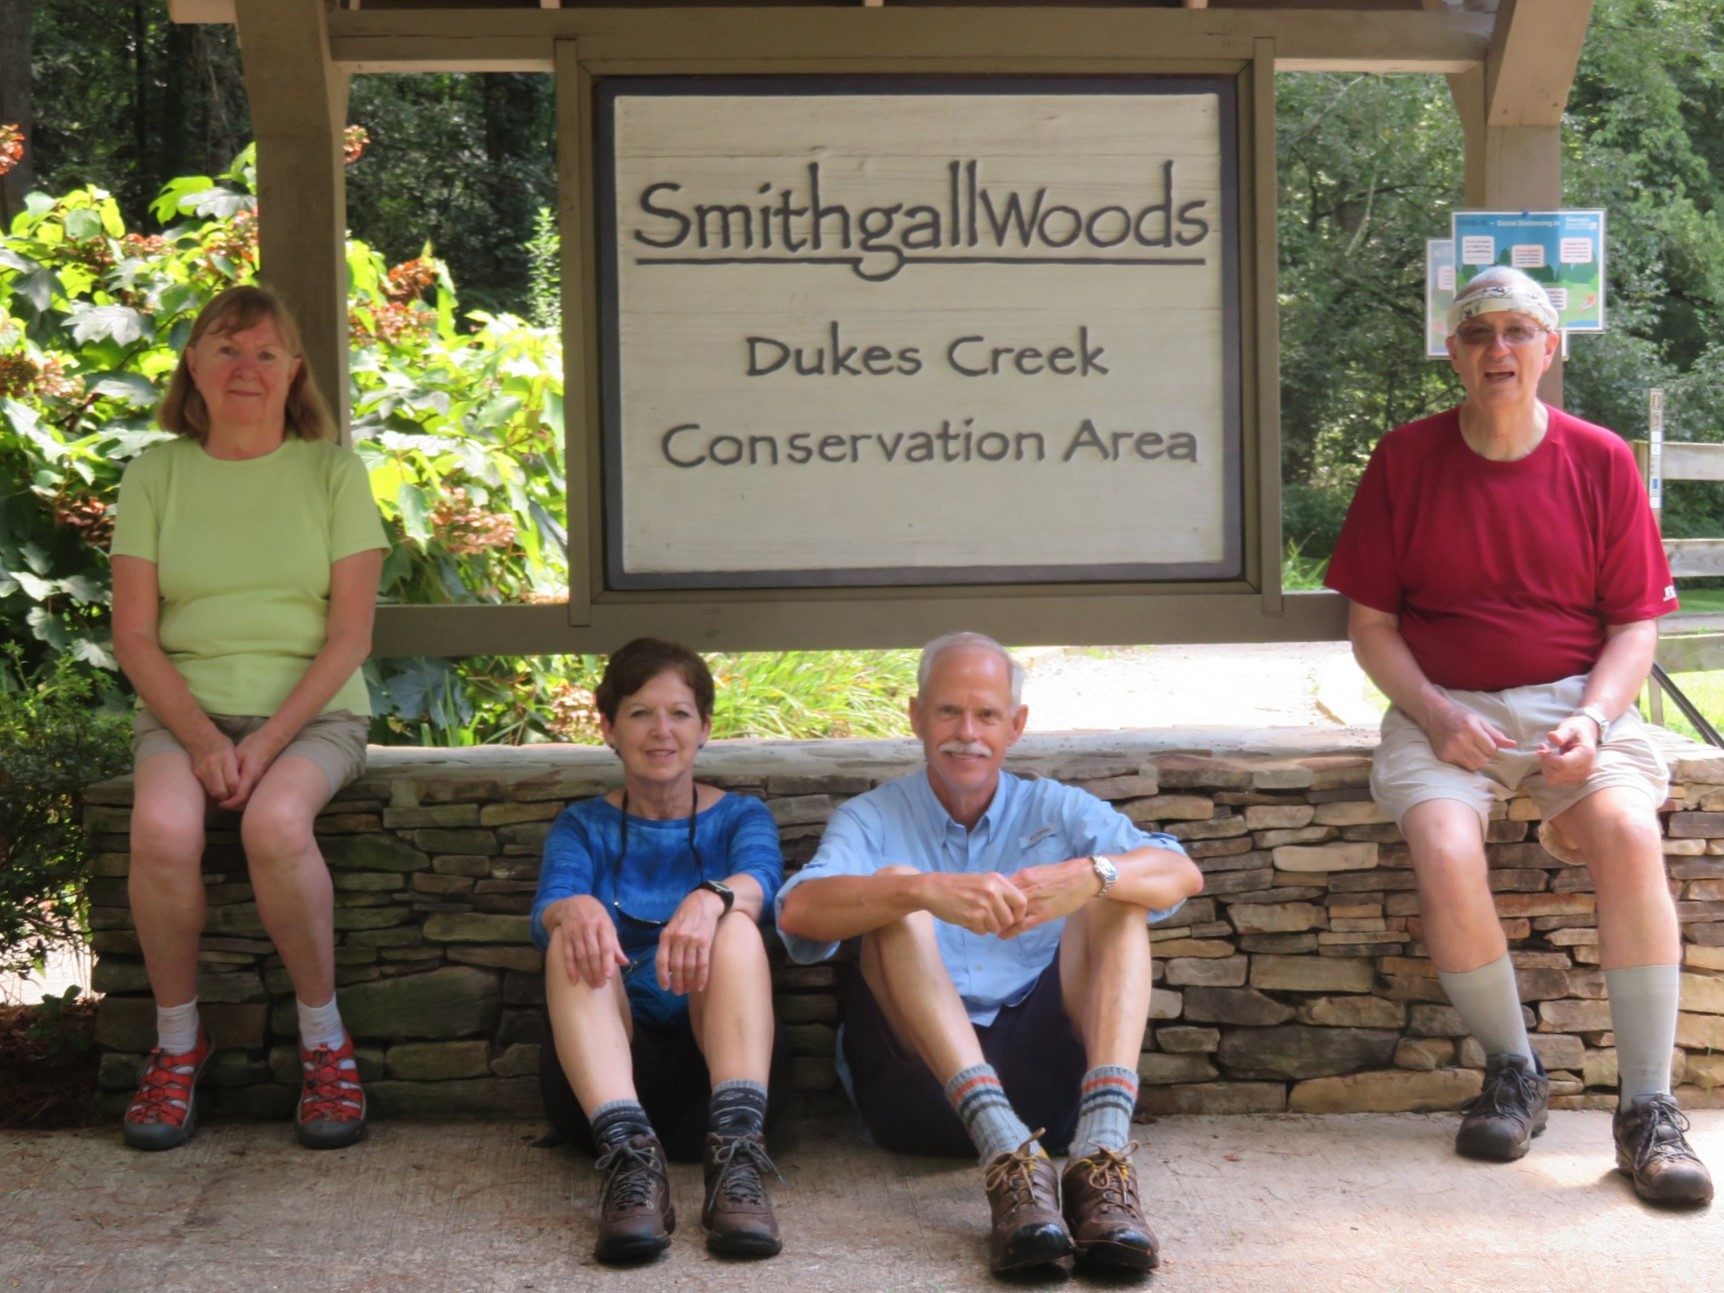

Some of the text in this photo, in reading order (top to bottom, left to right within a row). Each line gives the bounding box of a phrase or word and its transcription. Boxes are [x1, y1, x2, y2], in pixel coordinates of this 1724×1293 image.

[745, 320, 1109, 377] Dukes Creek
[661, 417, 1198, 469] Conservation Area
